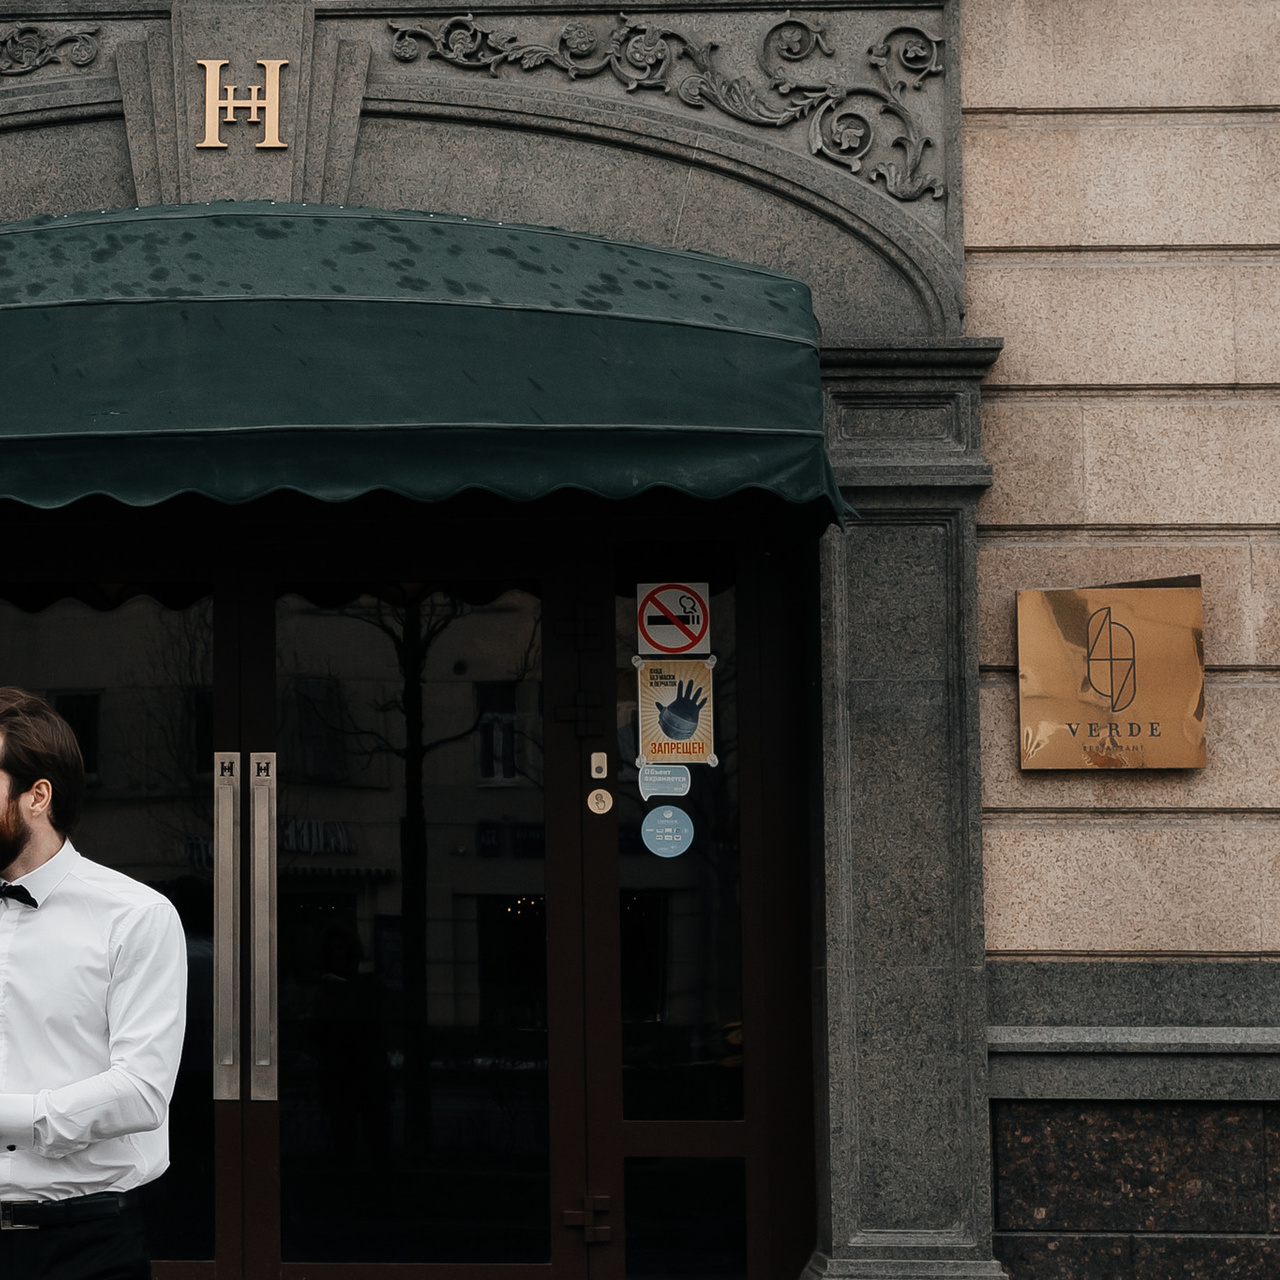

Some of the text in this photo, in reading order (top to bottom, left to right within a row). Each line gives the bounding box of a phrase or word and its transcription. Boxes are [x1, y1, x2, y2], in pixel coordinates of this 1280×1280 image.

[1065, 722, 1161, 737] VERDE
[650, 742, 705, 756] ЗАПРЕЩЕН
[644, 768, 672, 776] Объект
